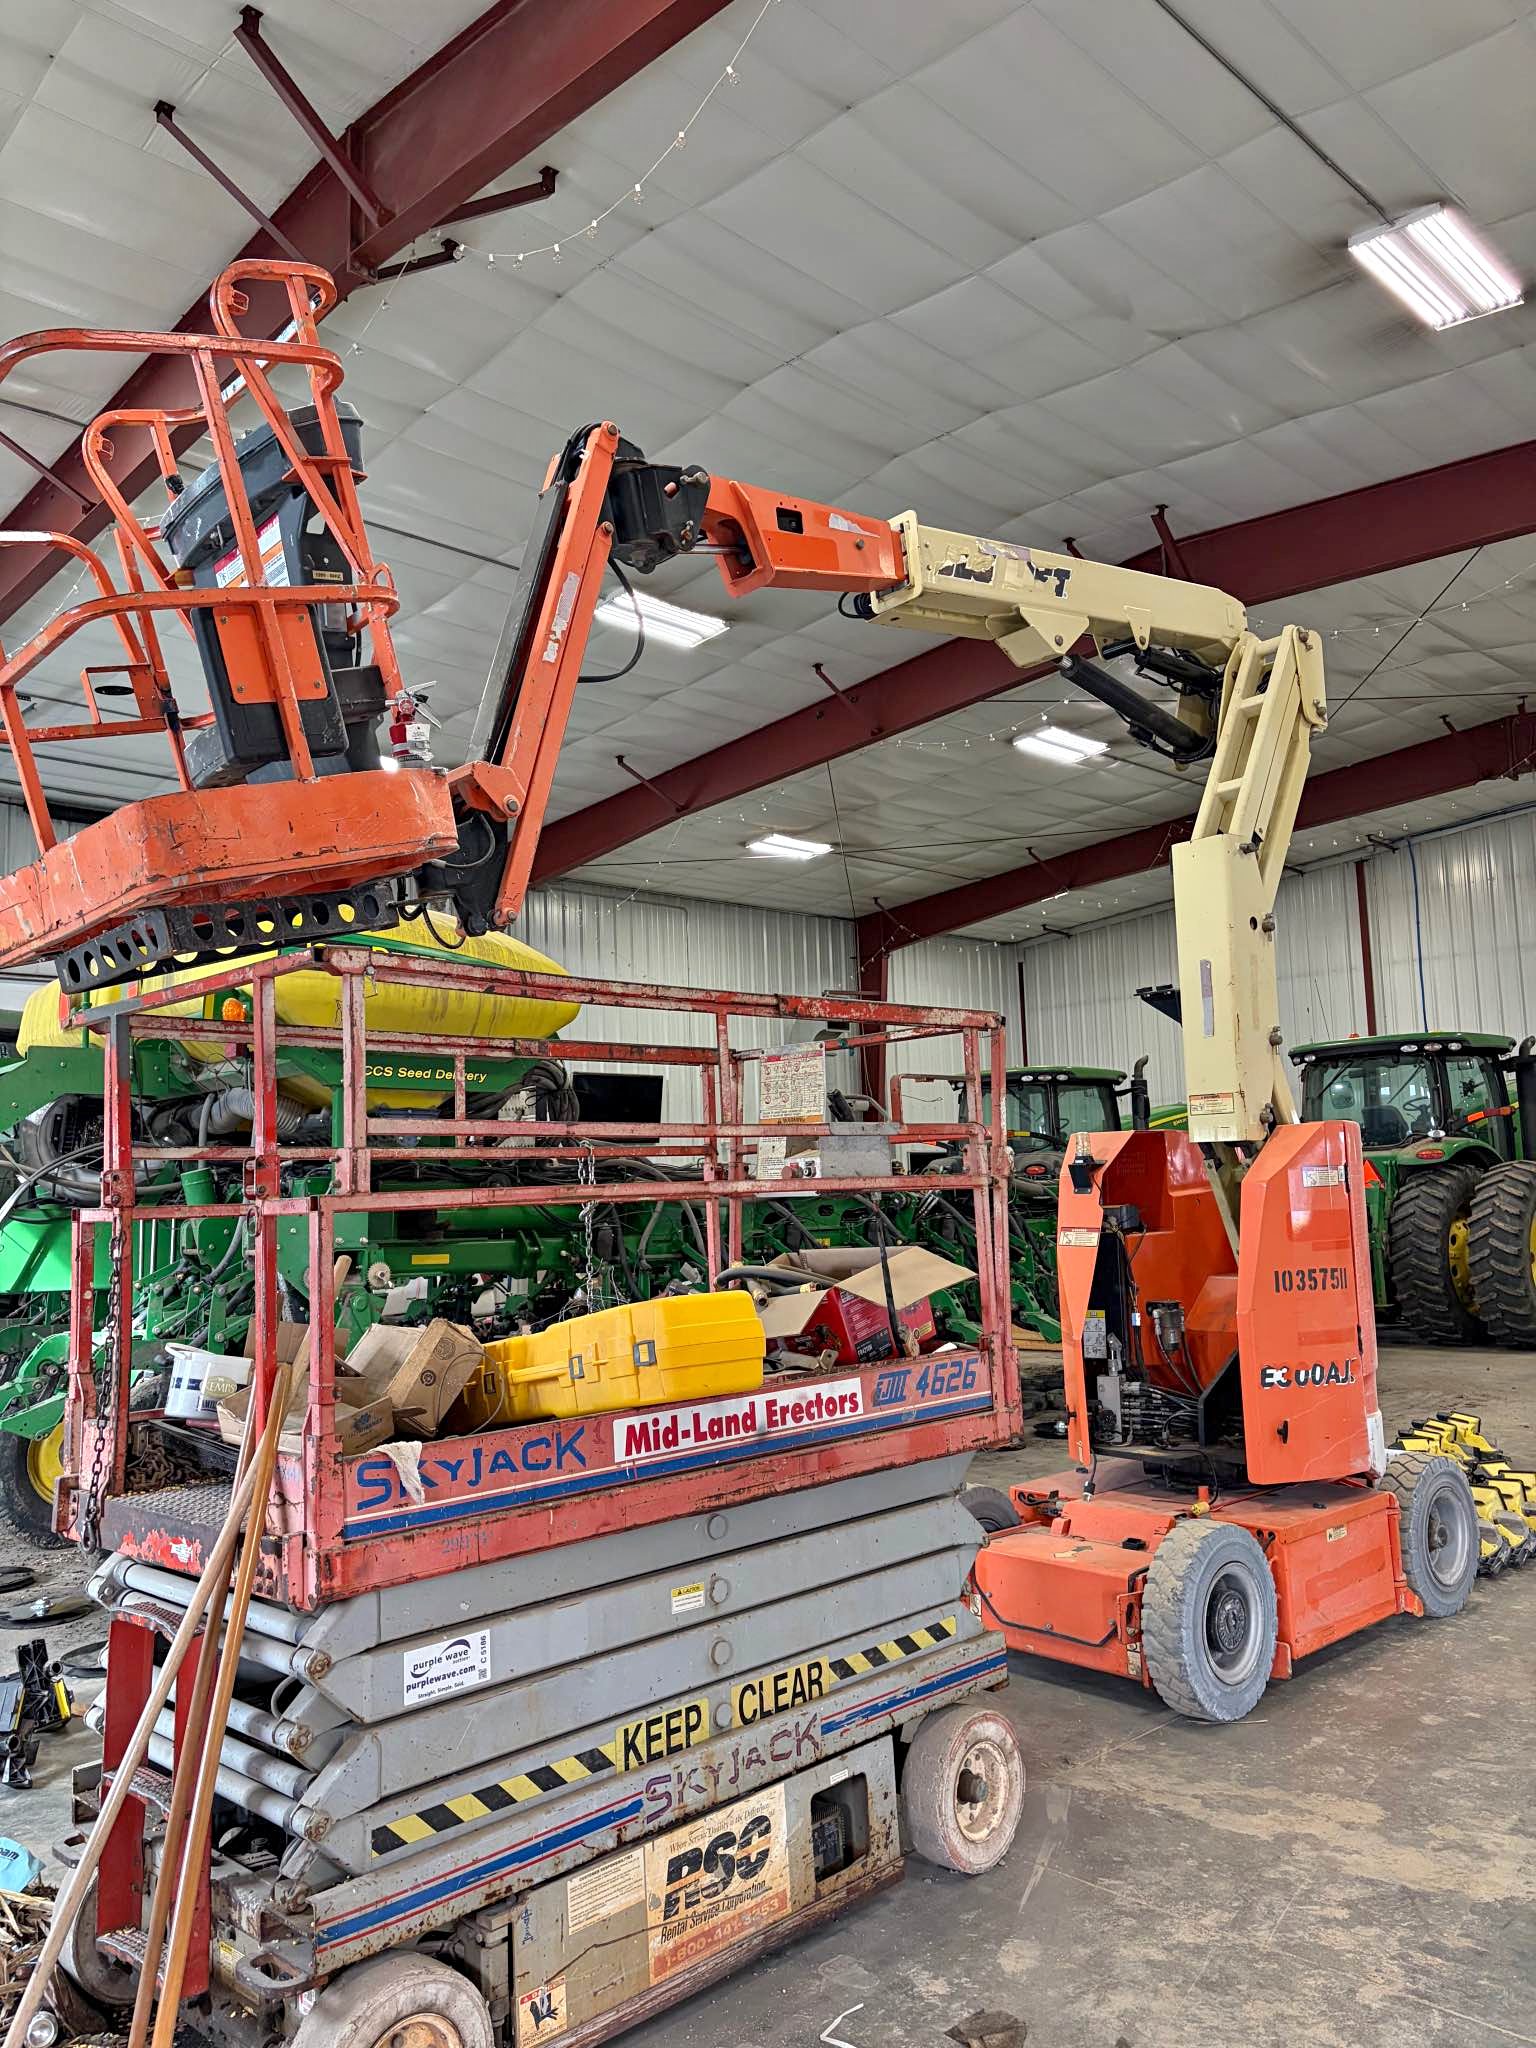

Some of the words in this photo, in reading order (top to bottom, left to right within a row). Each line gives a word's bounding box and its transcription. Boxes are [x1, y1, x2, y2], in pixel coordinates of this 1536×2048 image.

[397, 1066, 432, 1079] Seed
[916, 1357, 978, 1399] 4626
[624, 1401, 757, 1457] Mid-Land
[766, 1390, 859, 1429] Erectors
[406, 1664, 476, 1694] purplewave.com
[413, 1656, 443, 1673] purple
[445, 1649, 469, 1661] wave
[480, 1656, 487, 1664] C
[622, 1704, 703, 1772] KEEP
[738, 1660, 824, 1726] CLEAR
[644, 1711, 822, 1825] SKYJACK
[662, 1814, 772, 1922] RSC
[660, 1920, 688, 1945] Rental
[689, 1905, 720, 1930] Service
[722, 1879, 767, 1913] Corporation
